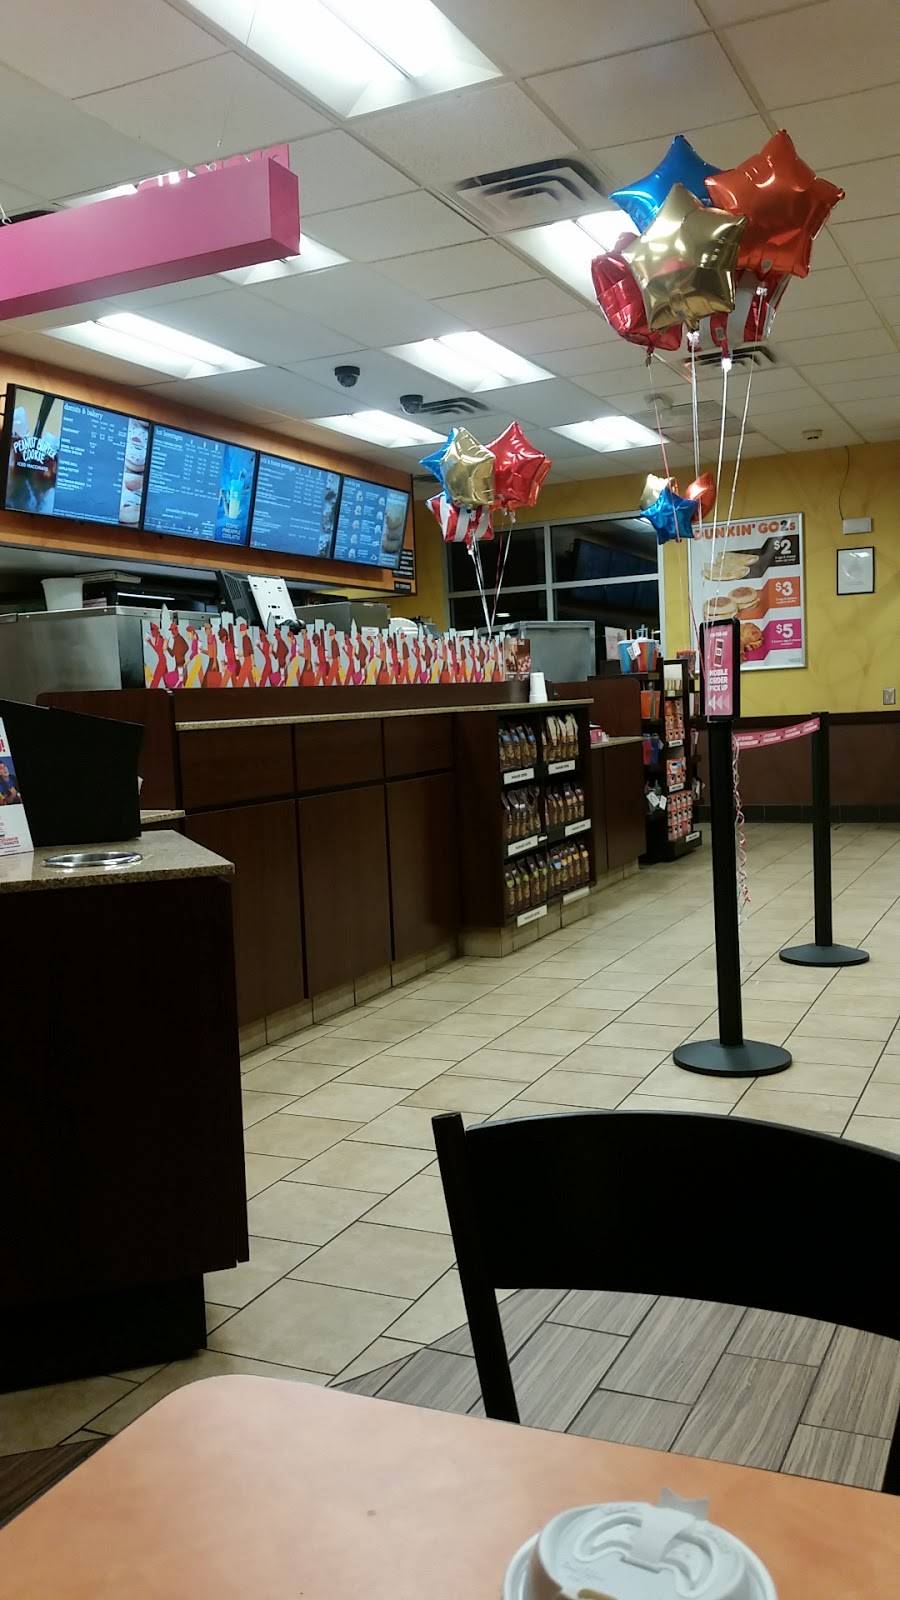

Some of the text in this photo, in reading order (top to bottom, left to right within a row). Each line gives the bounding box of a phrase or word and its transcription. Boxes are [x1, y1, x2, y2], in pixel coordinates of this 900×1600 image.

[87, 409, 103, 421] bakery
[13, 436, 38, 454] PEANUT
[23, 448, 46, 465] COOKIE
[774, 539, 792, 555] $2
[775, 581, 793, 596] $3
[776, 623, 794, 638] $5
[709, 668, 728, 676] MOBILE
[709, 676, 728, 685] ORDER
